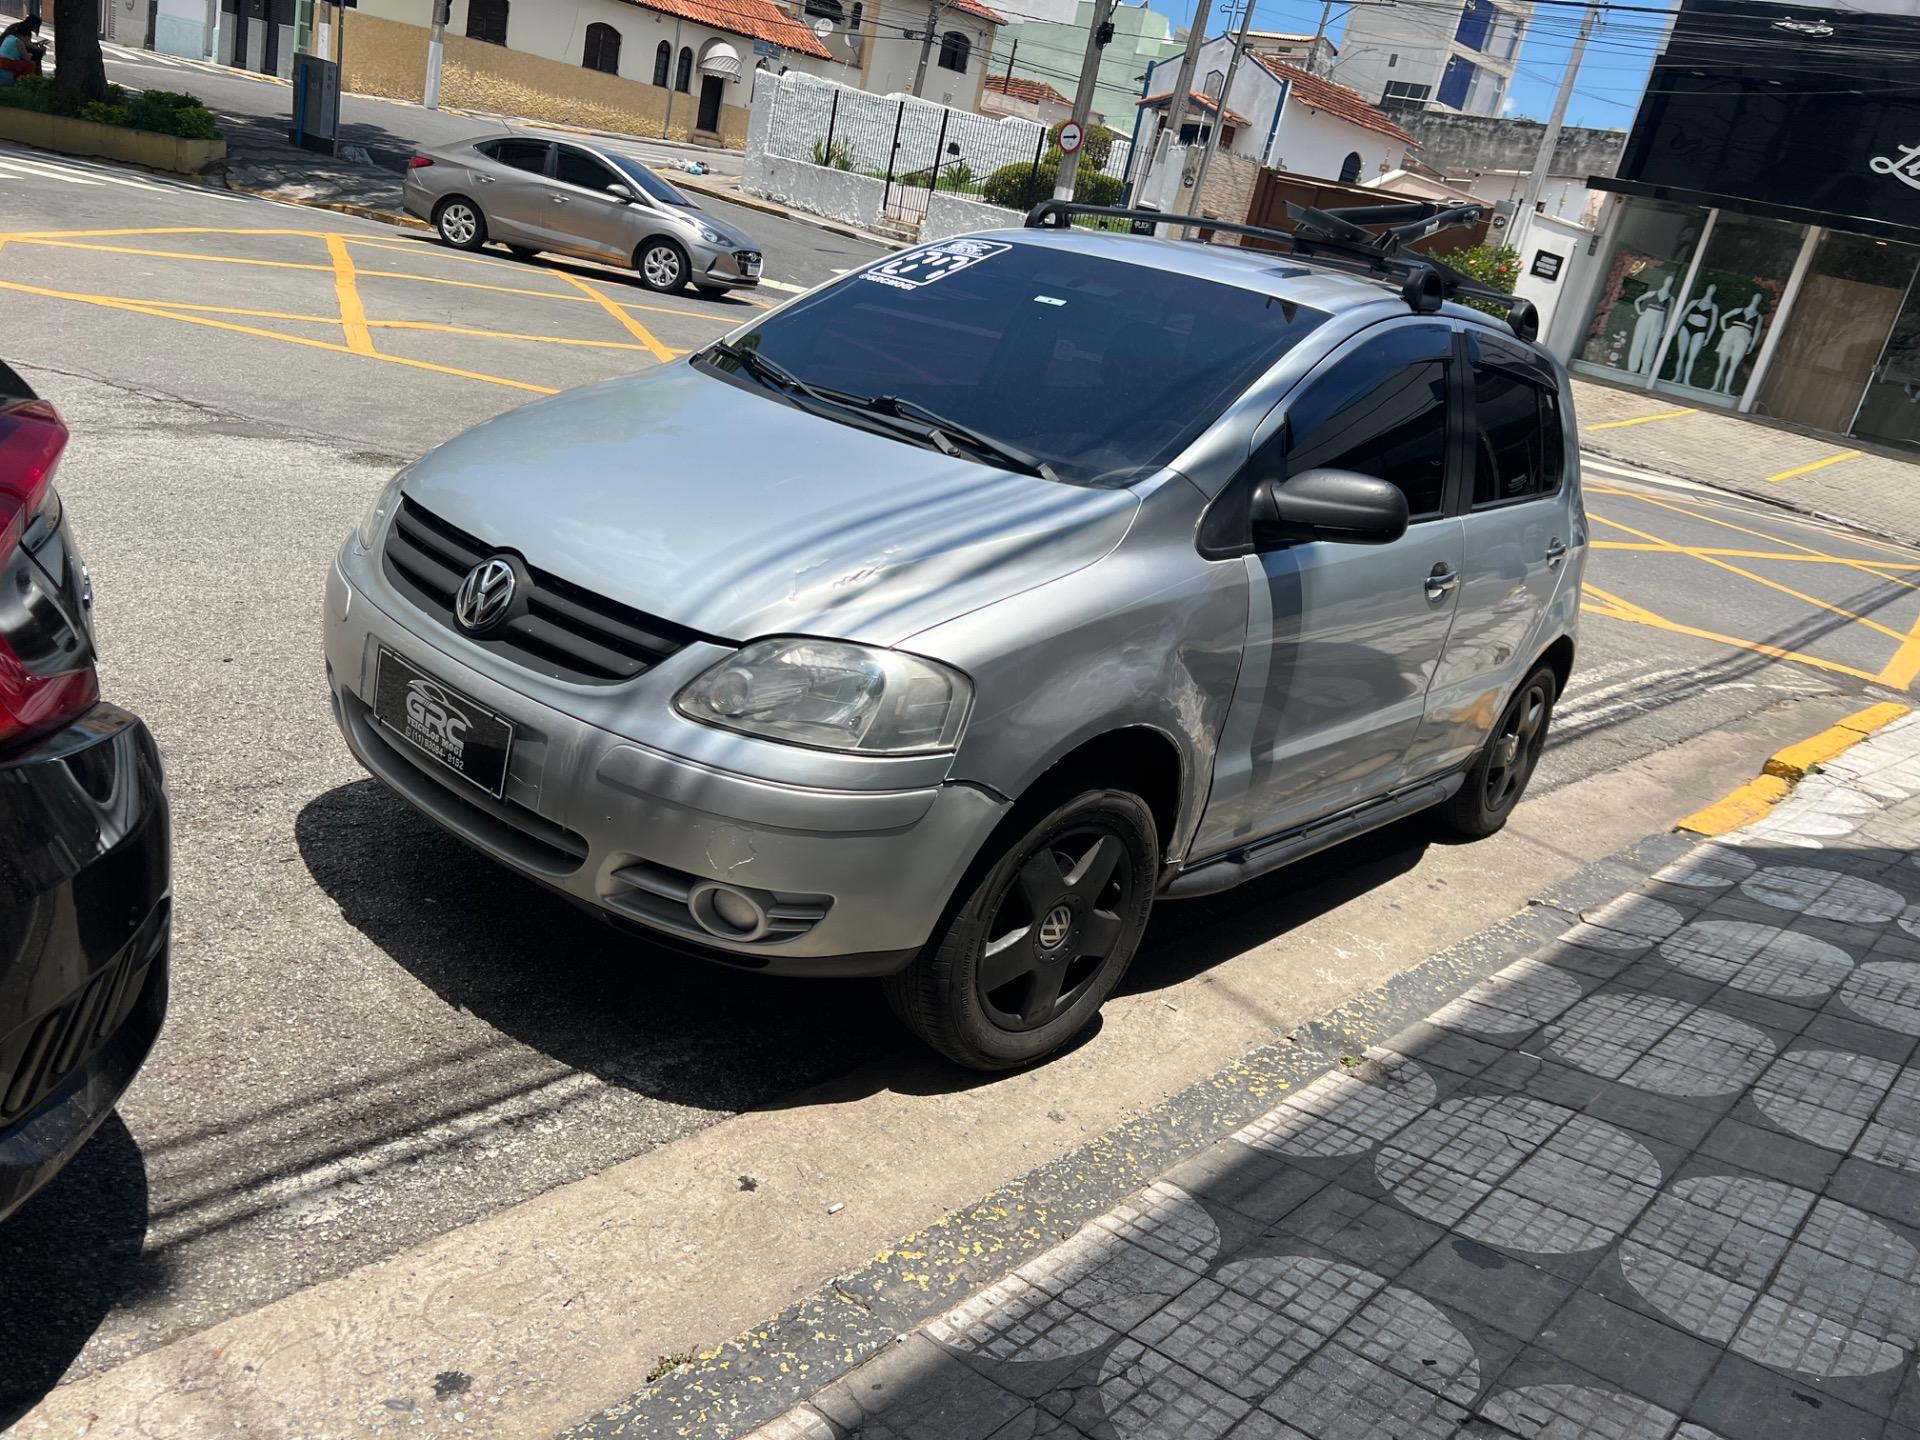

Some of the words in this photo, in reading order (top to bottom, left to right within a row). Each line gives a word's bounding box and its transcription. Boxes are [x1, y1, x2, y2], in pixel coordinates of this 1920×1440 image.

[406, 691, 467, 750] GRC
[407, 715, 440, 743] VEICULOS
[440, 737, 463, 758] MOGI
